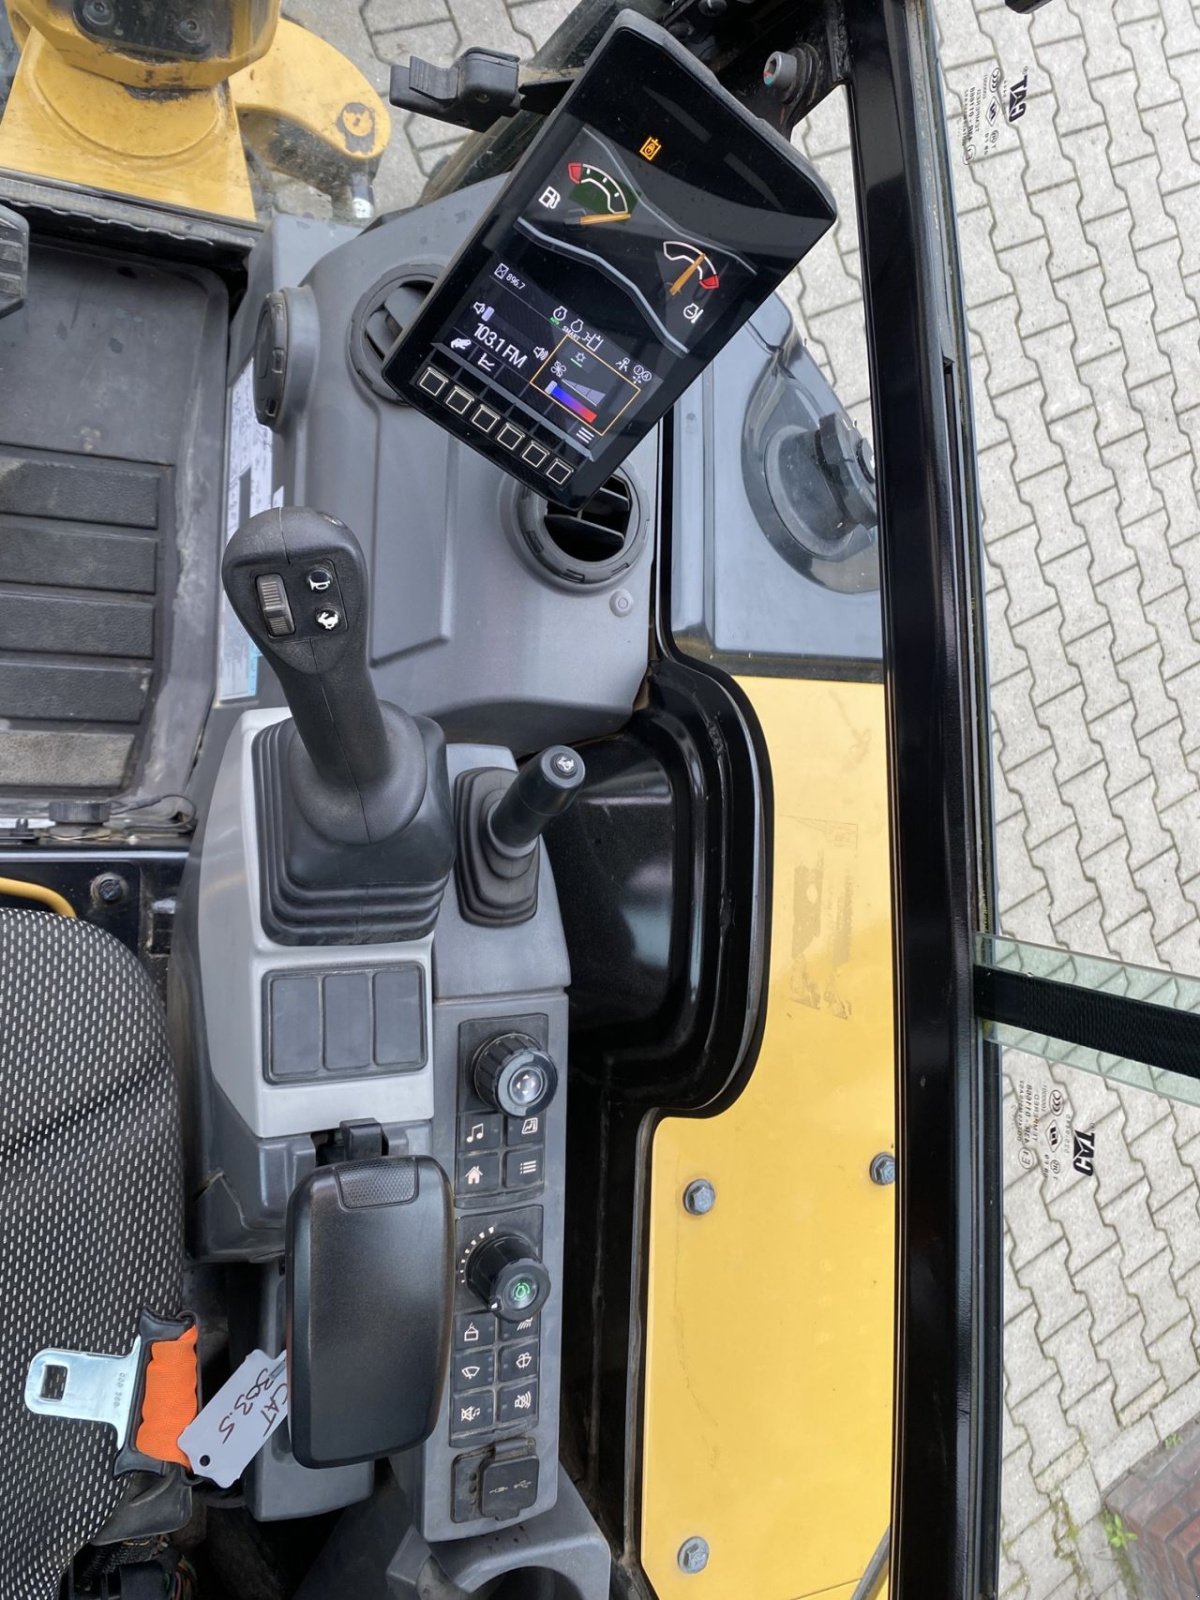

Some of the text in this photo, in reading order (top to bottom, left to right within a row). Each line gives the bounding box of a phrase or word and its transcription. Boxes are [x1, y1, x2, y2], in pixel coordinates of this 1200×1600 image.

[506, 273, 526, 290] 896.7
[474, 322, 528, 369] 103.1 FM
[561, 325, 581, 341] SMART
[261, 1383, 289, 1437] CAT
